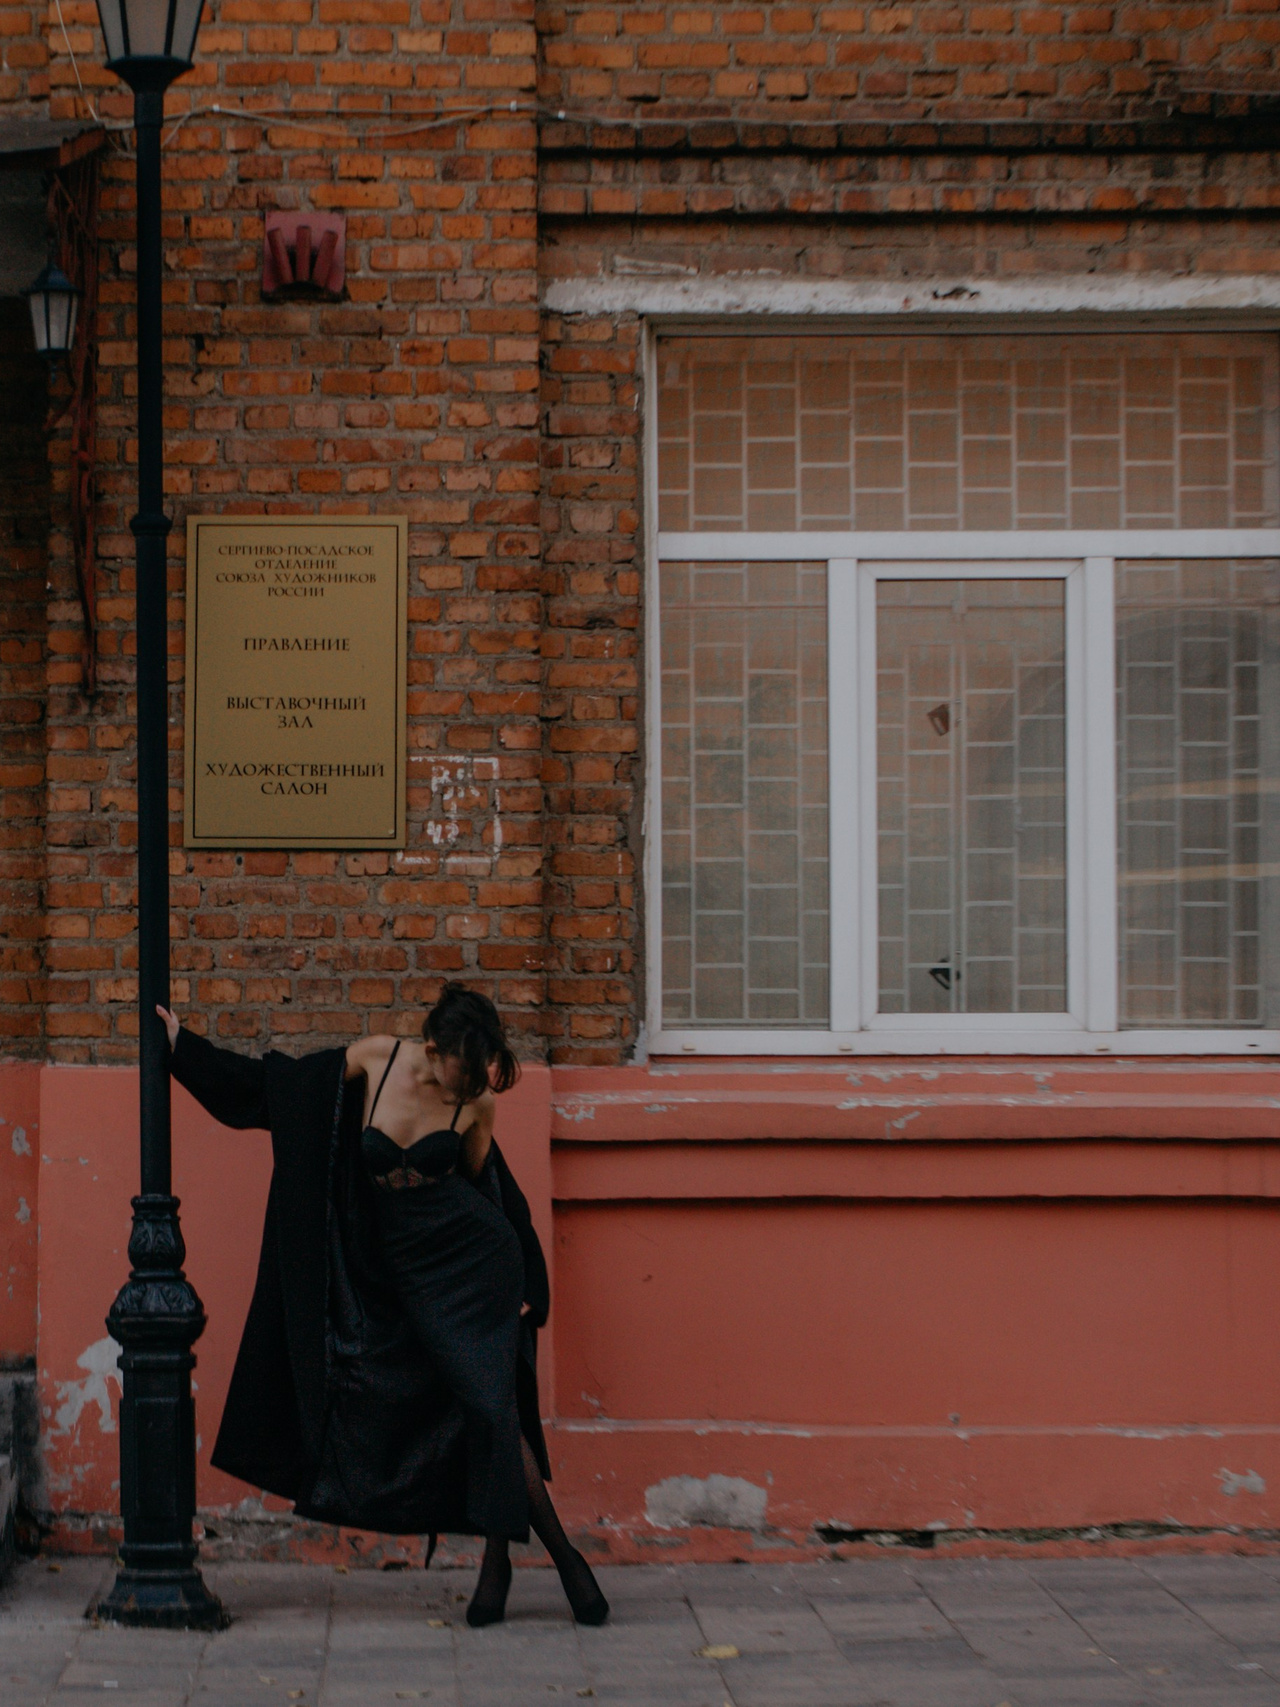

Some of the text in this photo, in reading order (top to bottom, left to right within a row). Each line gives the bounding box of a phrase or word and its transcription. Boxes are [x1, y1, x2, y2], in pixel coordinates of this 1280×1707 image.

[255, 559, 337, 570] ОТДЕЛЕНИЕ
[216, 573, 377, 584] СОЮЗА ХУДОЖНИКОВ
[268, 587, 324, 597] РОССИИ
[244, 638, 350, 651] ПРАВЛЕНИЕ
[226, 696, 367, 710] ВЫСТАВОЧНЫЙ
[278, 715, 314, 728] ЗАЛ
[206, 763, 385, 777] ХУДОЖЕСТВЕННЫЙ
[260, 782, 328, 795] САЛОН
